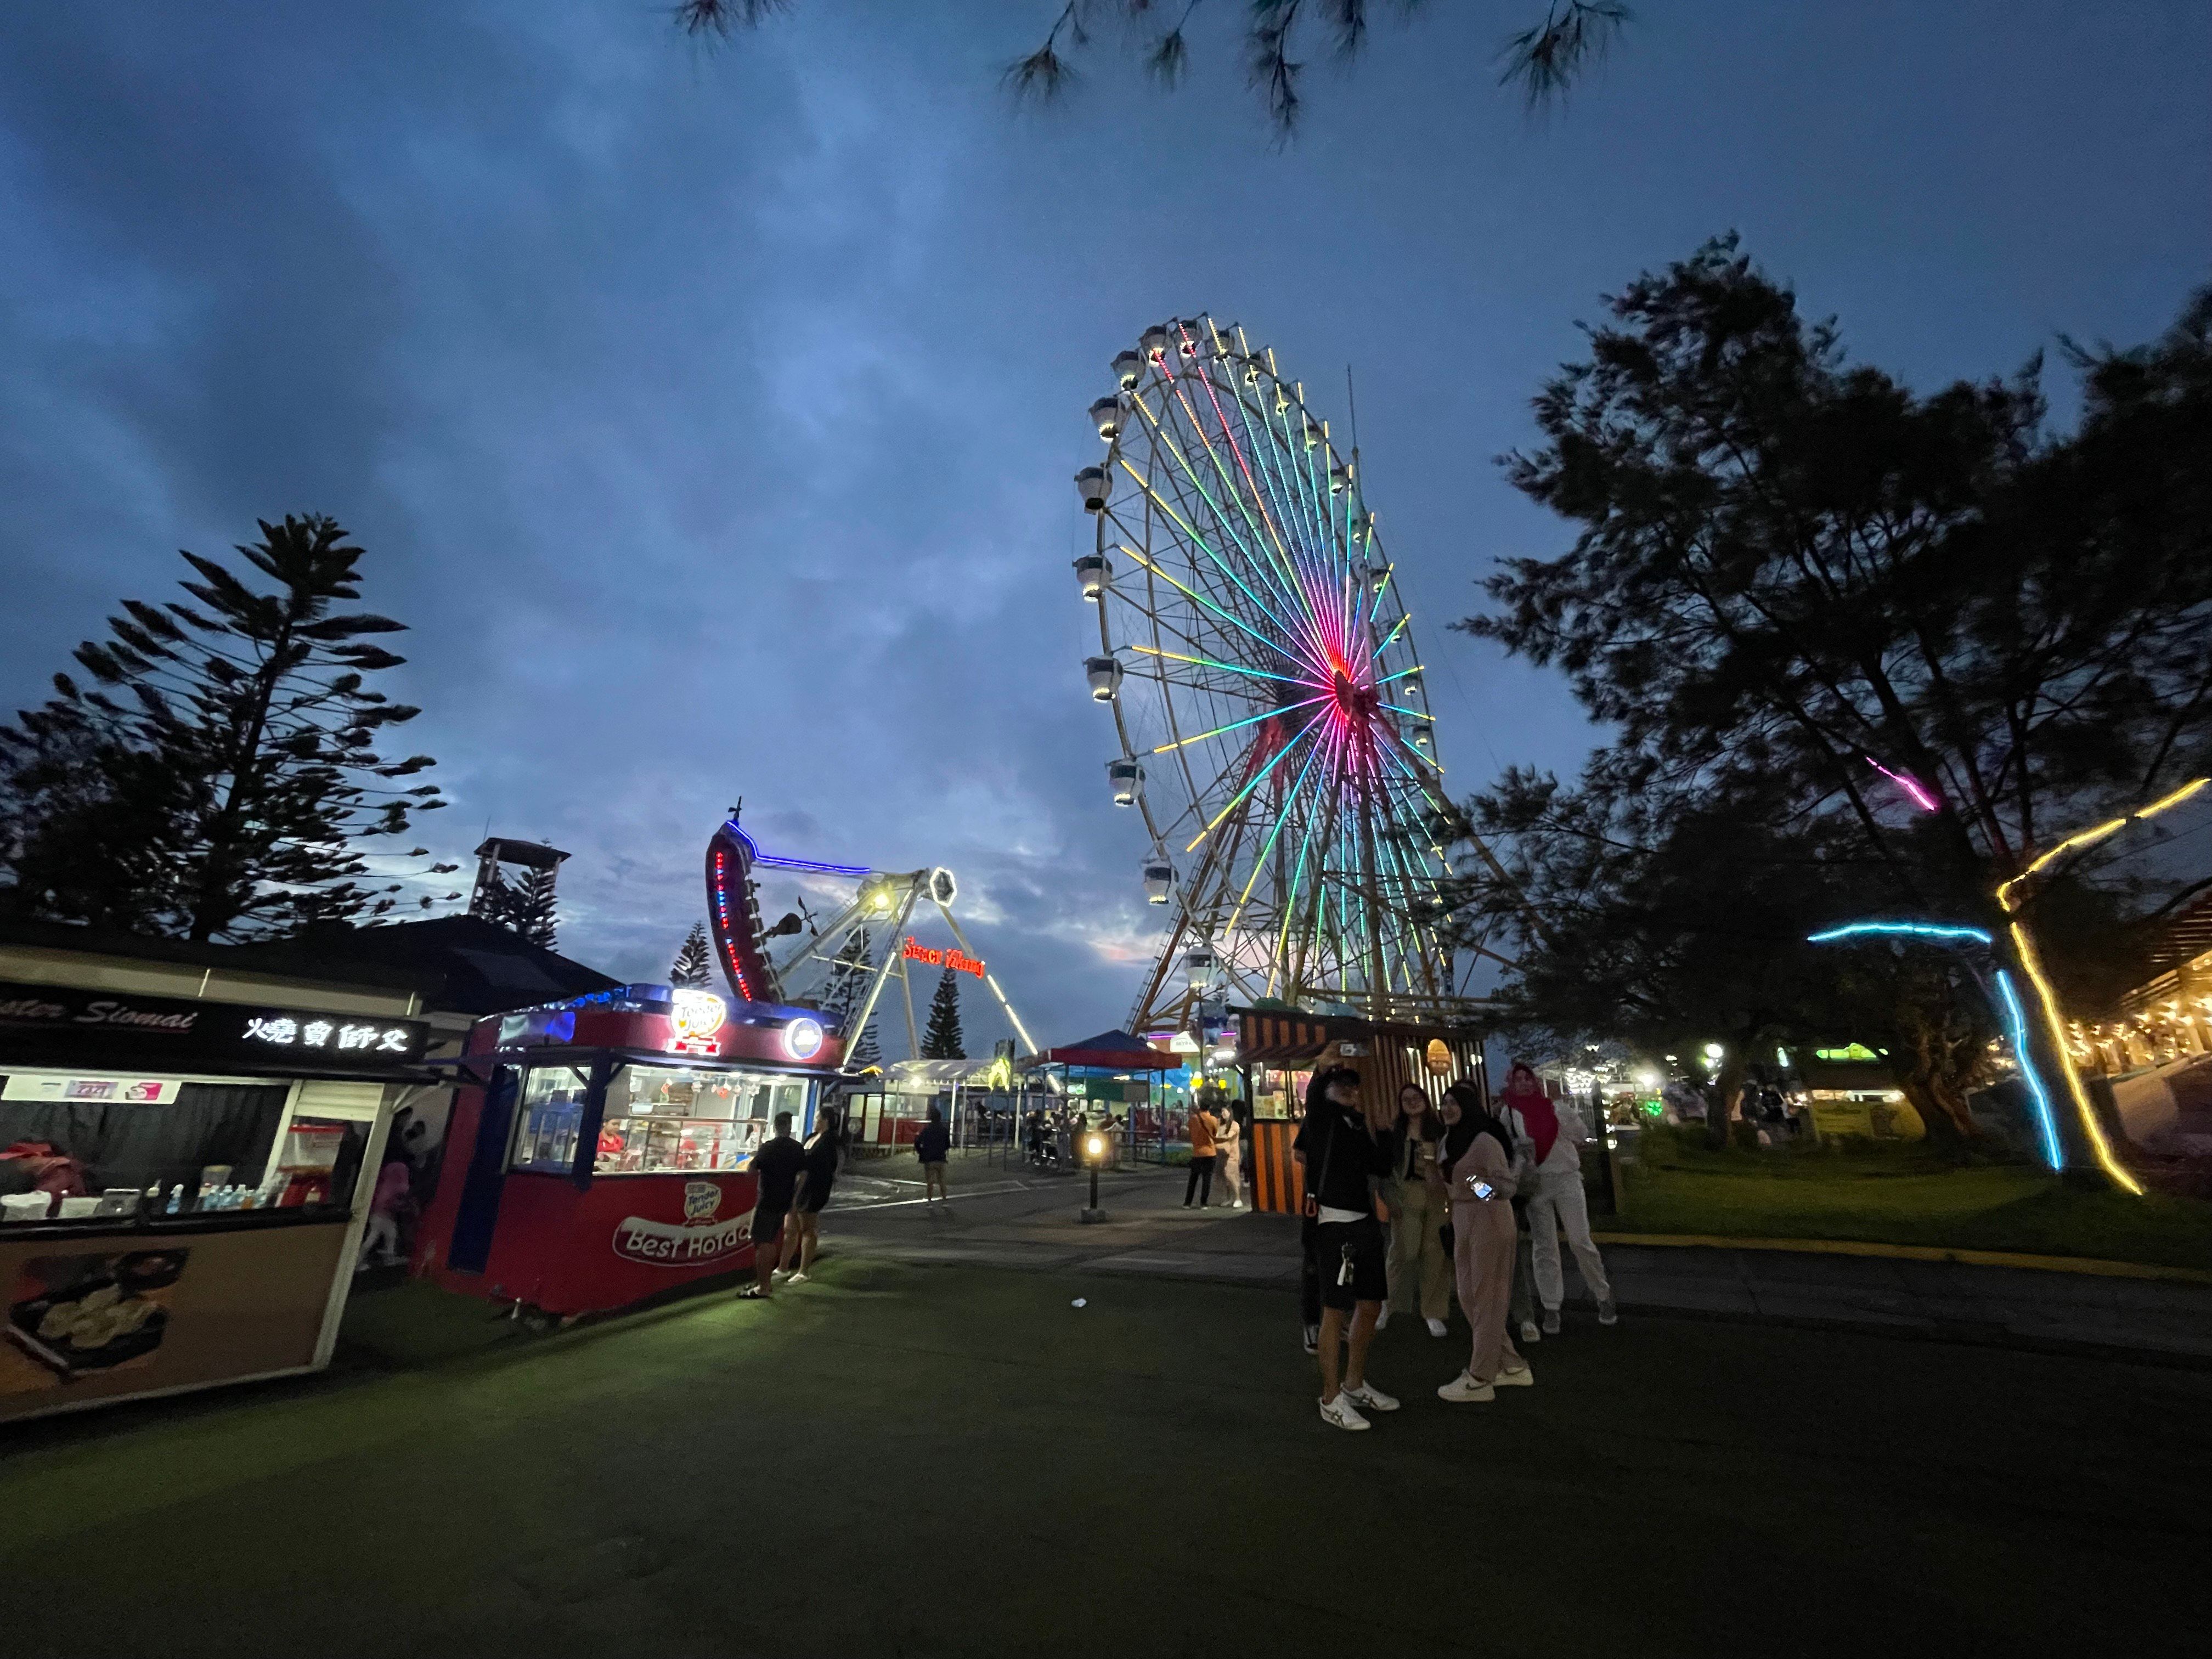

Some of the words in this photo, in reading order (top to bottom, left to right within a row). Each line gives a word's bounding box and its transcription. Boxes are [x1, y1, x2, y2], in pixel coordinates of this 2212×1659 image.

[72, 1001, 199, 1028] Siomai
[689, 1189, 719, 1206] Tender
[687, 1225, 751, 1257] Hotdo
